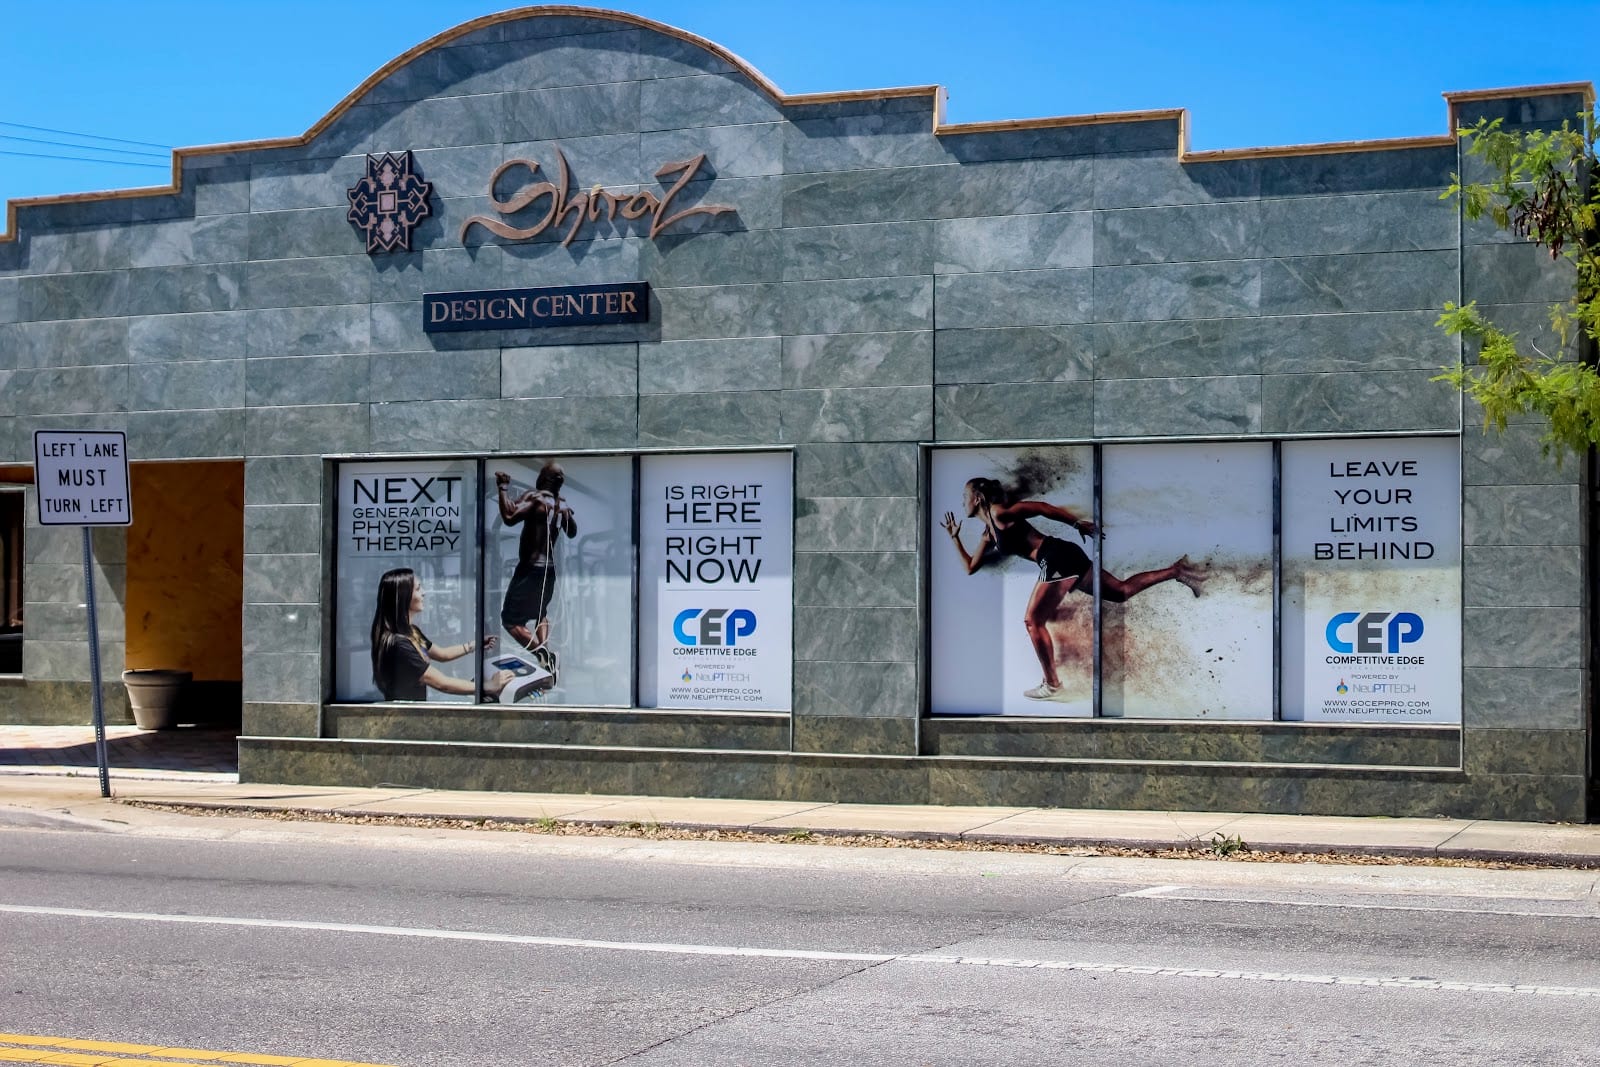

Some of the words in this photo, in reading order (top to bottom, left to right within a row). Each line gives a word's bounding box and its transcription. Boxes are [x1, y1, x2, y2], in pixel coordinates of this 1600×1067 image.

[430, 297, 526, 323] DESIGN
[531, 291, 638, 318] CENTER
[43, 443, 76, 457] LEFT
[84, 443, 120, 457] LANE
[1330, 460, 1418, 477] LEAVE
[58, 469, 107, 486] MUST
[353, 477, 462, 504] NEXT
[665, 485, 685, 501] IS
[691, 484, 762, 500] RIGHT
[1334, 488, 1412, 505] YOUR
[45, 498, 81, 513] TURN
[91, 498, 123, 513] LEFT
[352, 506, 460, 519] GENERATION
[666, 502, 762, 524] HERE
[352, 519, 461, 535] PHYSICAL
[1330, 516, 1418, 533] LIMITS
[352, 536, 460, 552] THERAPY
[666, 536, 762, 556] RIGHT
[1314, 541, 1435, 560] BEHIND
[666, 558, 762, 584] NOW
[673, 608, 757, 646] CEP
[1325, 612, 1424, 654] CEP
[672, 647, 731, 656] COMPETITIVE
[733, 648, 757, 657] EDGE
[1325, 656, 1394, 665] COMPETITIVE
[1397, 656, 1425, 665] EDGE
[669, 694, 763, 702] WWW.NEUPTTECH.COM
[671, 687, 761, 695] WWW.GOCEPPRO.COM
[1322, 707, 1432, 715] WWW.NEUPTTECH.COM
[1324, 700, 1430, 708] WWW.GOCEPPRO.COM
